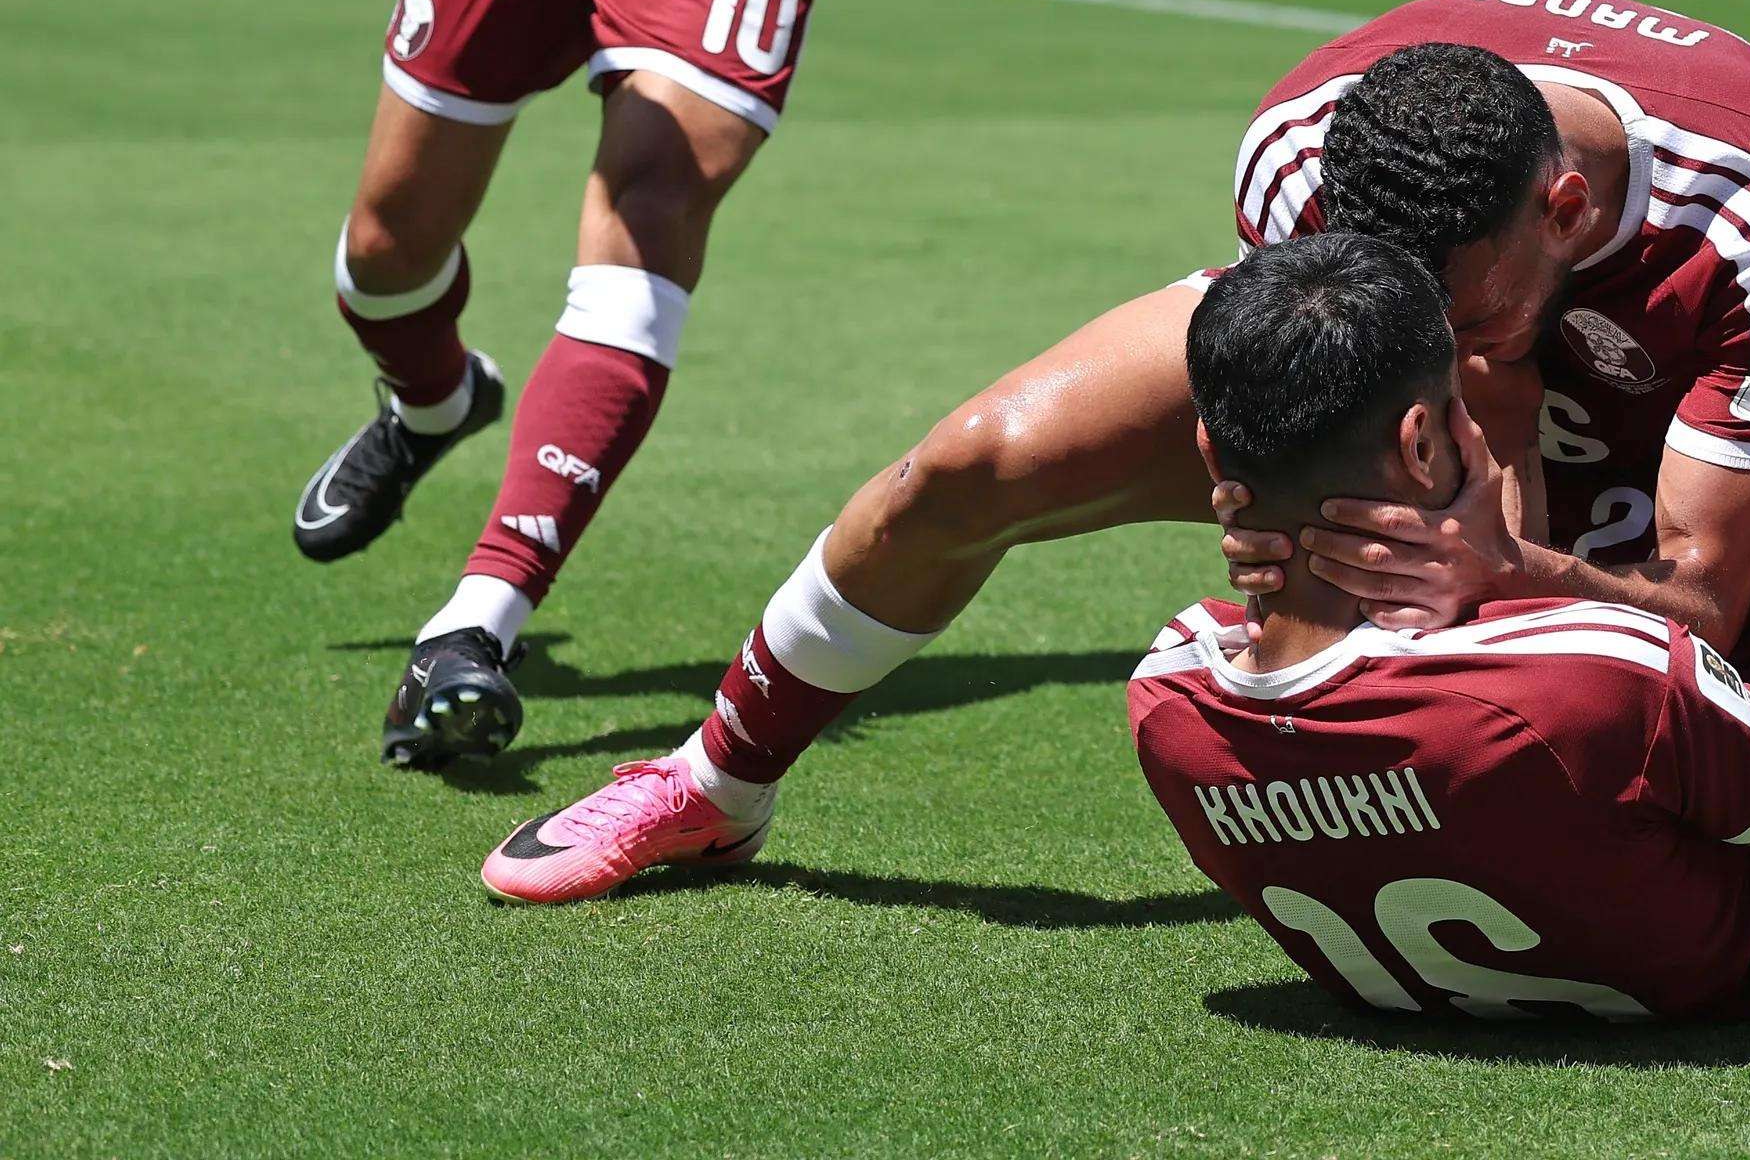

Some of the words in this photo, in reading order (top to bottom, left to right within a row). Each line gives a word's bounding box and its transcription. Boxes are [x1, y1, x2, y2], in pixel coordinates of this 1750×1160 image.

[1593, 359, 1639, 381] QFA
[536, 444, 601, 494] QFA
[1194, 767, 1441, 846] KHOUKHI
[1262, 878, 1654, 1023] 16
